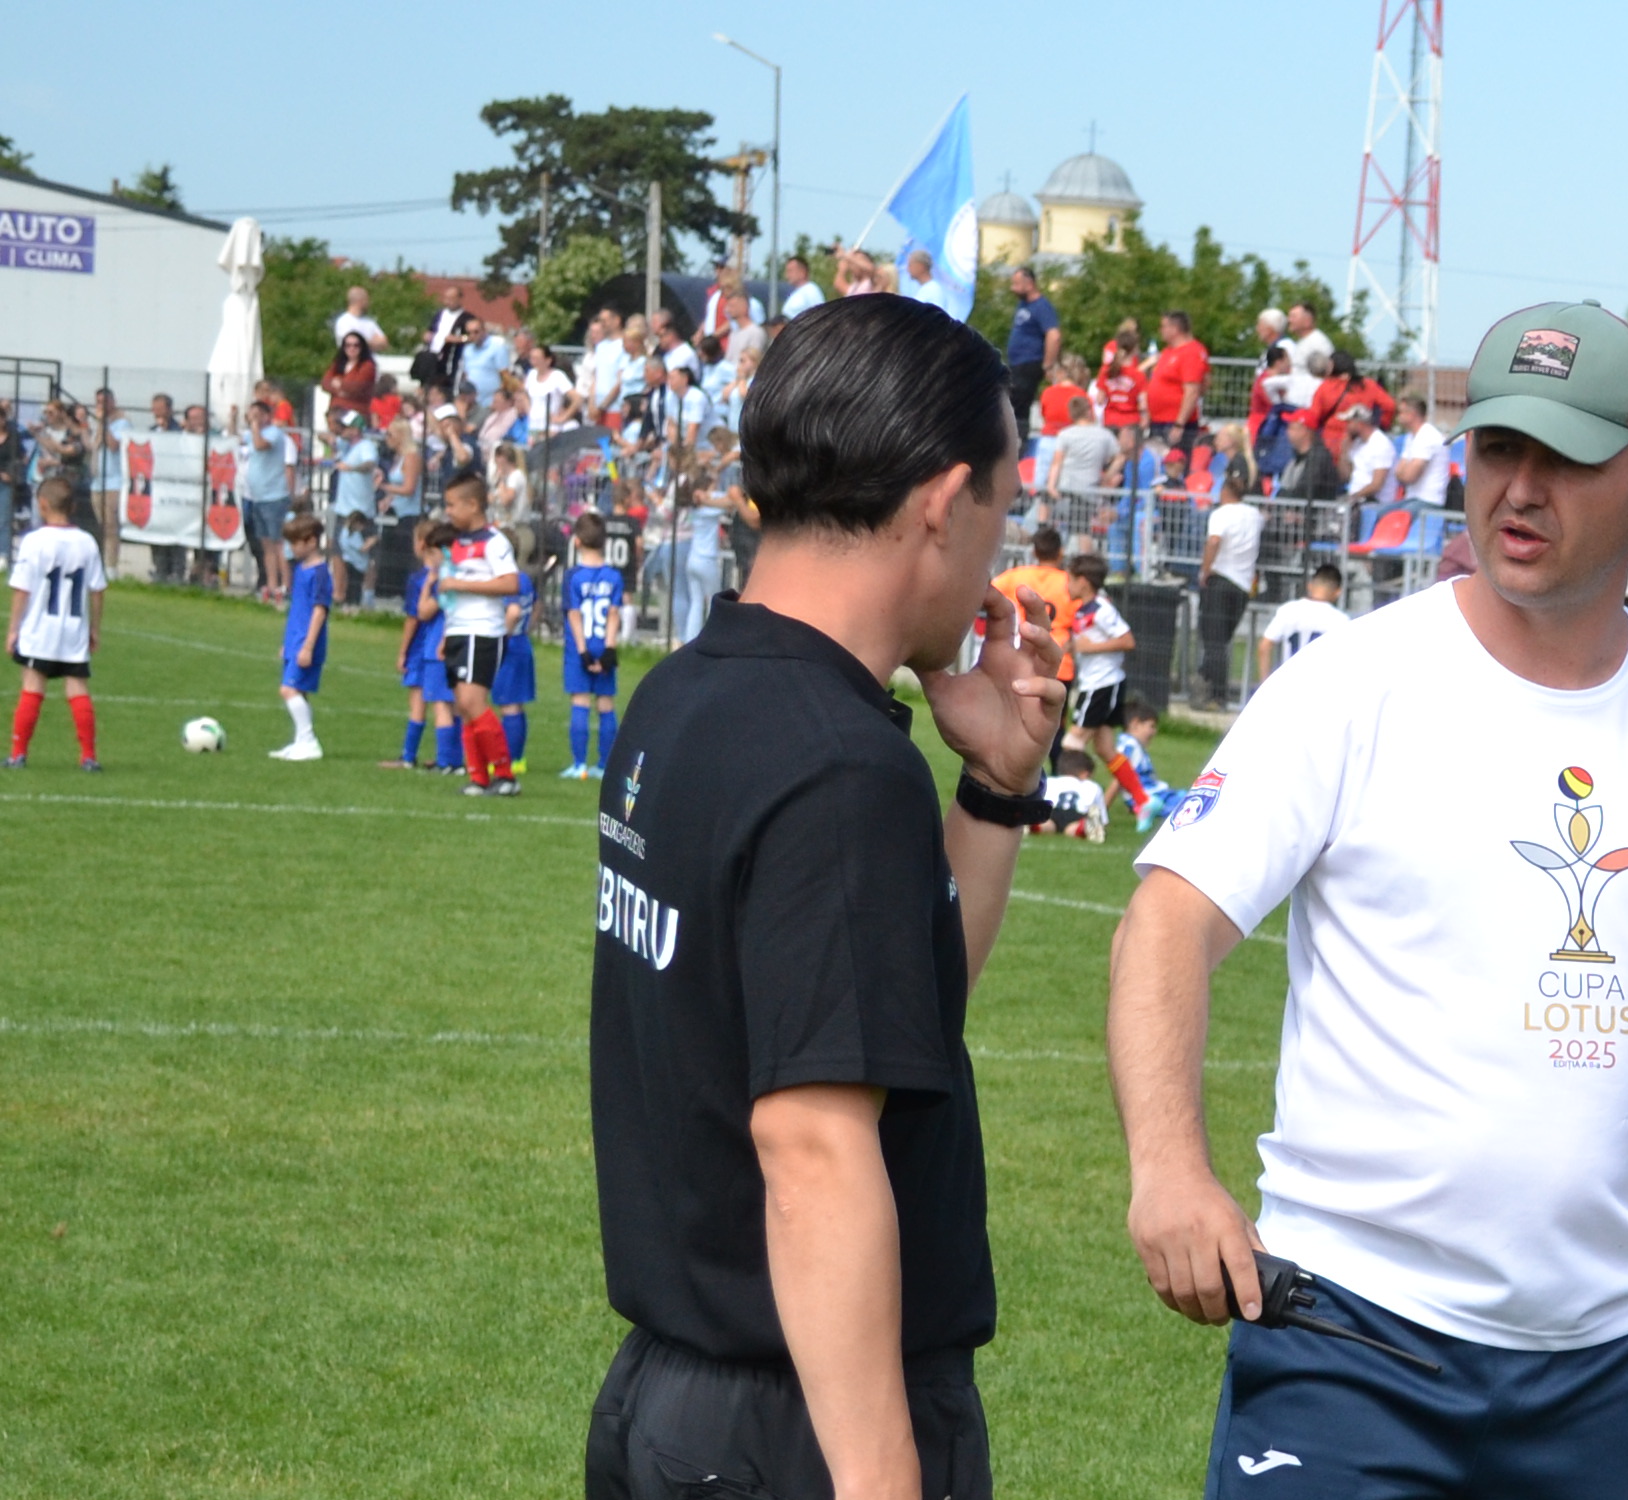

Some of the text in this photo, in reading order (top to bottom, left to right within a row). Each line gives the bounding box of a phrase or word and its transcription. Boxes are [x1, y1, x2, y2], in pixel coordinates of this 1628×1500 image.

[0, 212, 83, 245] AUTO
[24, 248, 84, 270] CLIMA
[46, 566, 84, 617] 11
[597, 863, 679, 971] BITRU
[1538, 971, 1625, 1001] CUPA
[1548, 1039, 1616, 1069] 2025
